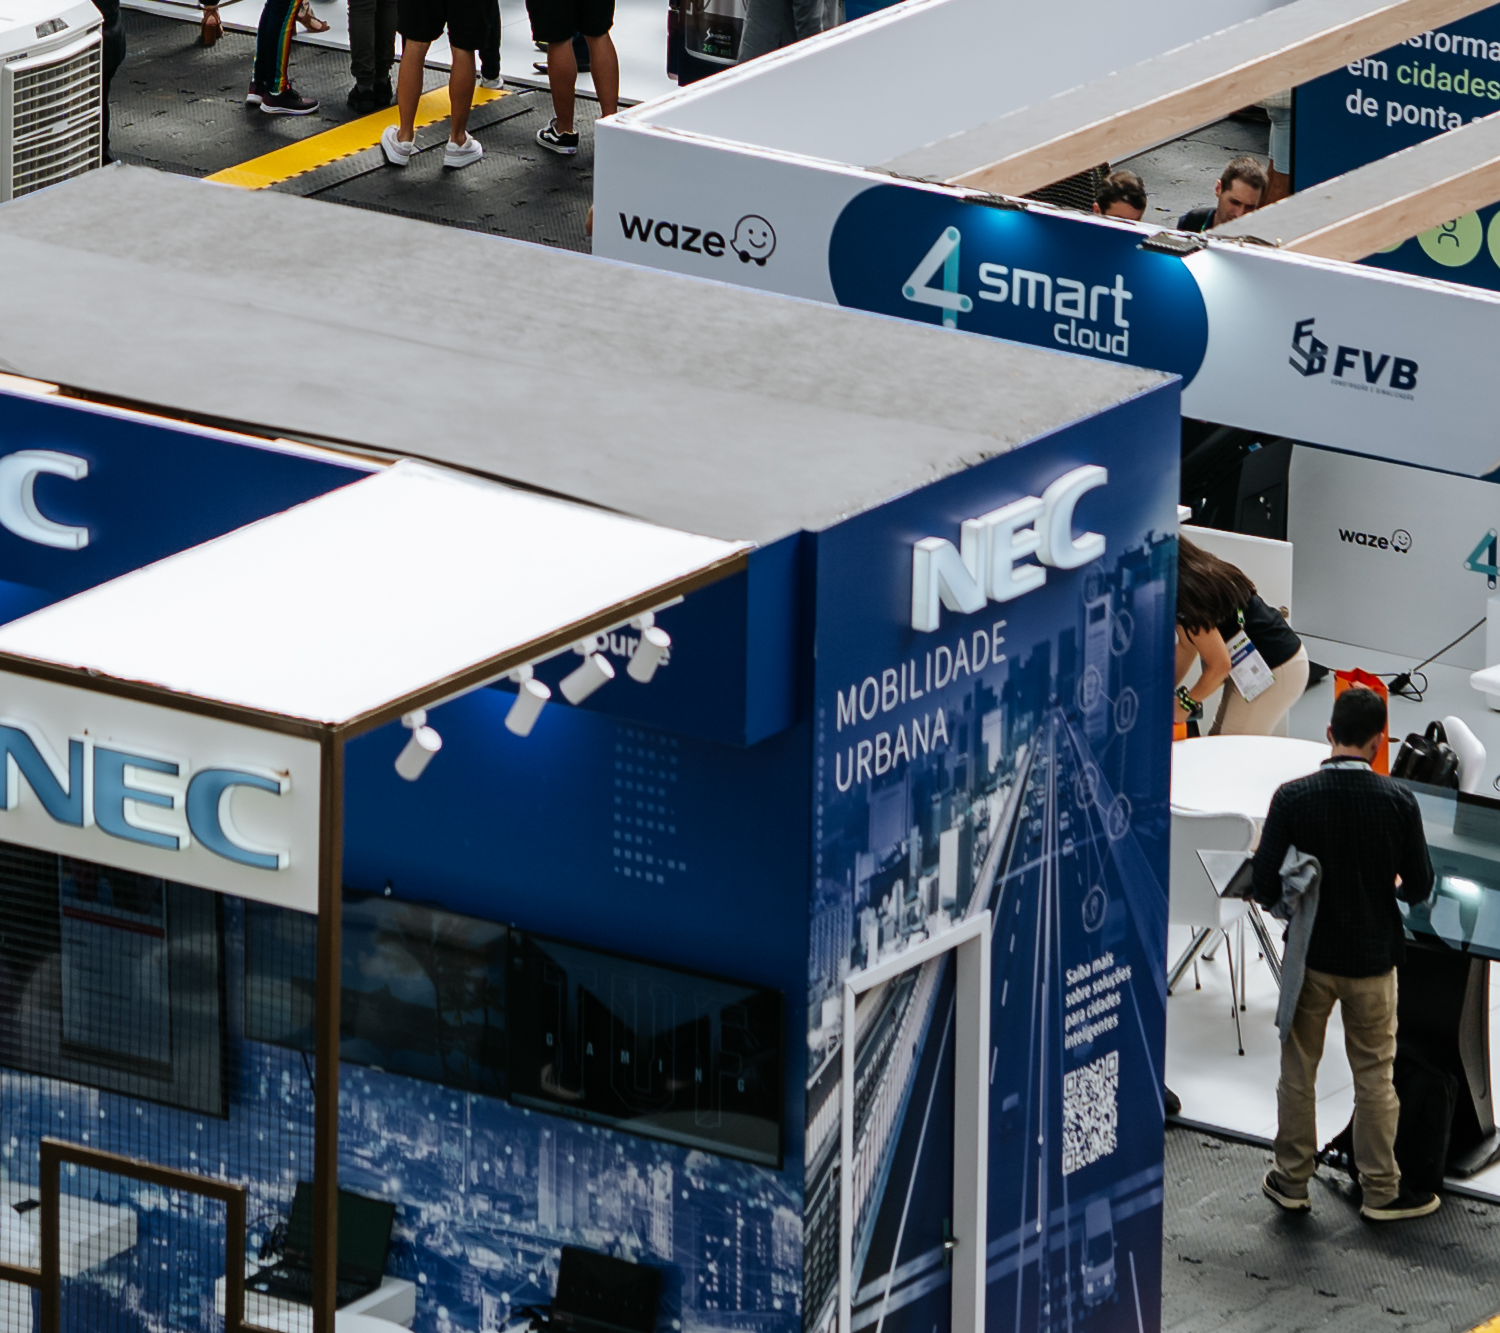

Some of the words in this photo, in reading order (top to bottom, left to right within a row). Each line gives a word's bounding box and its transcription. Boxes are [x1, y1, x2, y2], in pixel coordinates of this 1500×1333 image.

[618, 211, 726, 258] waze
[978, 261, 1133, 328] smart
[1054, 319, 1129, 357] cloud
[1333, 344, 1419, 391] FVB
[910, 463, 1109, 634] NEC
[1338, 528, 1389, 550] waze
[835, 618, 1008, 733] MOBILIDADE
[834, 708, 951, 793] URBANA
